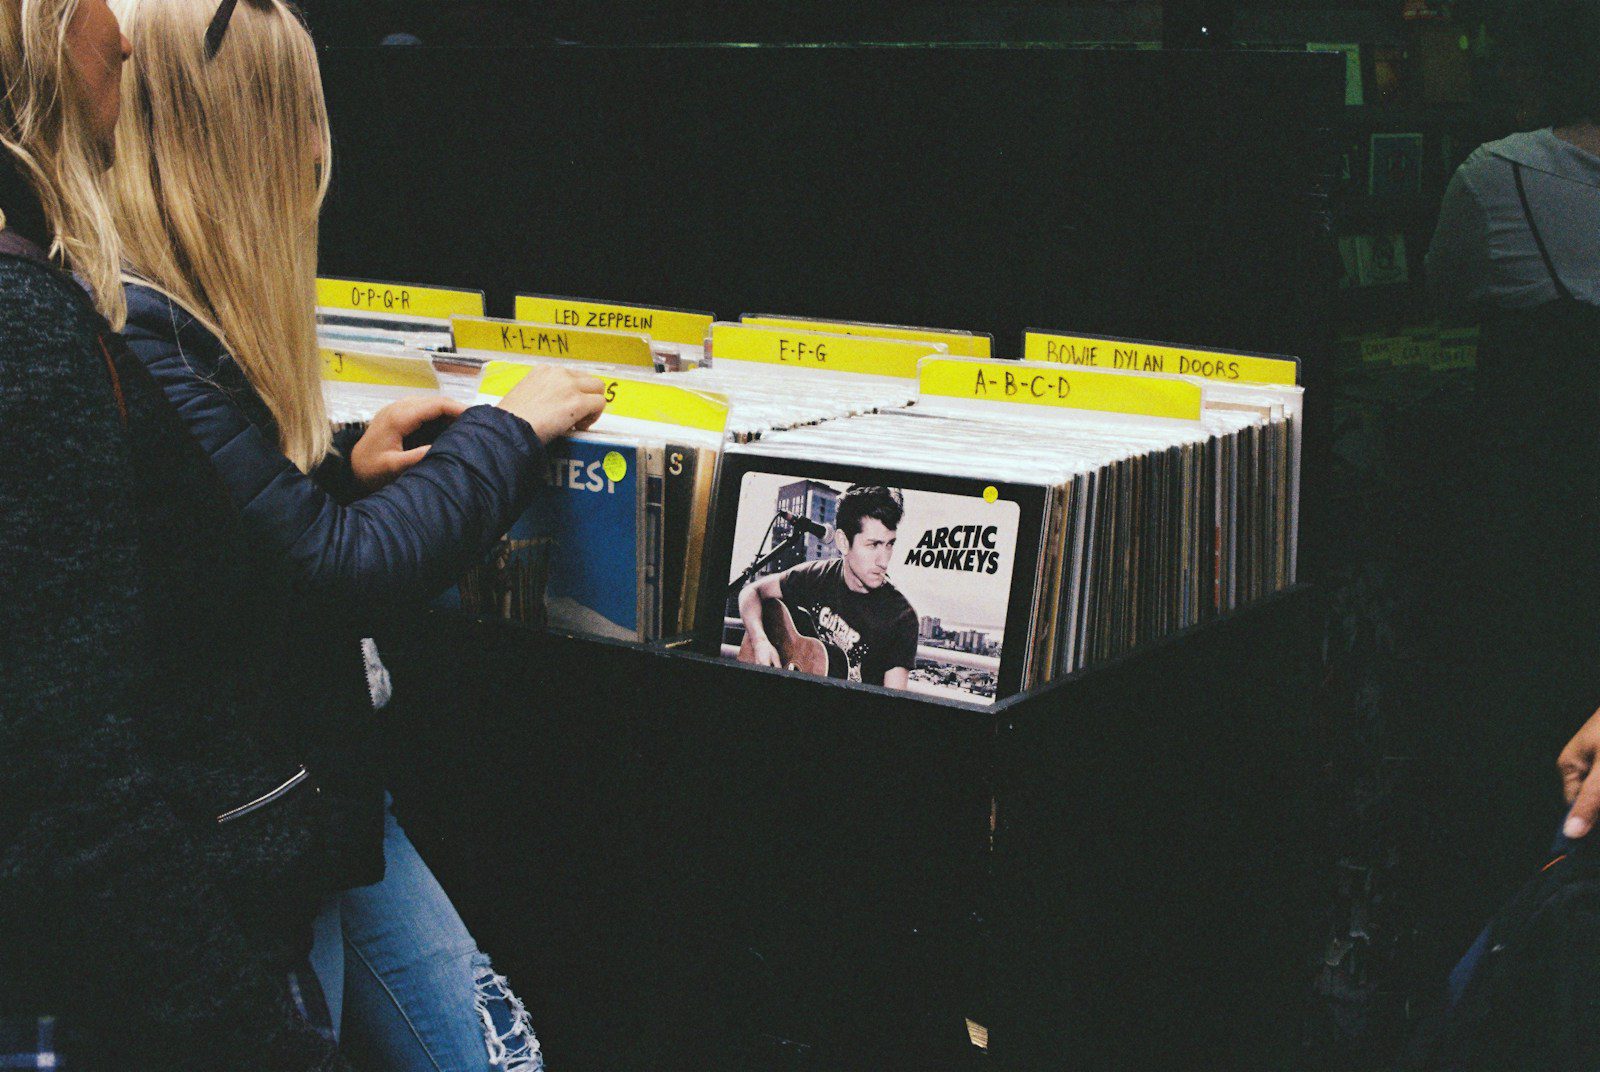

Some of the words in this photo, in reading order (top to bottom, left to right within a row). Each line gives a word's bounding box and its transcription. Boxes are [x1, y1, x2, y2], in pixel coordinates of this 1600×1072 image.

[351, 287, 410, 309] O-P-Q-R
[554, 308, 579, 326] LED
[585, 311, 653, 330] ZEPPELIN
[501, 326, 570, 354] K-L-M-N
[779, 338, 827, 363] E-F-G
[1047, 339, 1097, 368] BOWIE
[1113, 348, 1164, 374] DYLAN
[1179, 355, 1240, 380] DOORS
[974, 368, 1071, 399] A-B-C-D
[916, 524, 998, 550] ARCTIC
[904, 548, 1000, 575] MONKEYS
